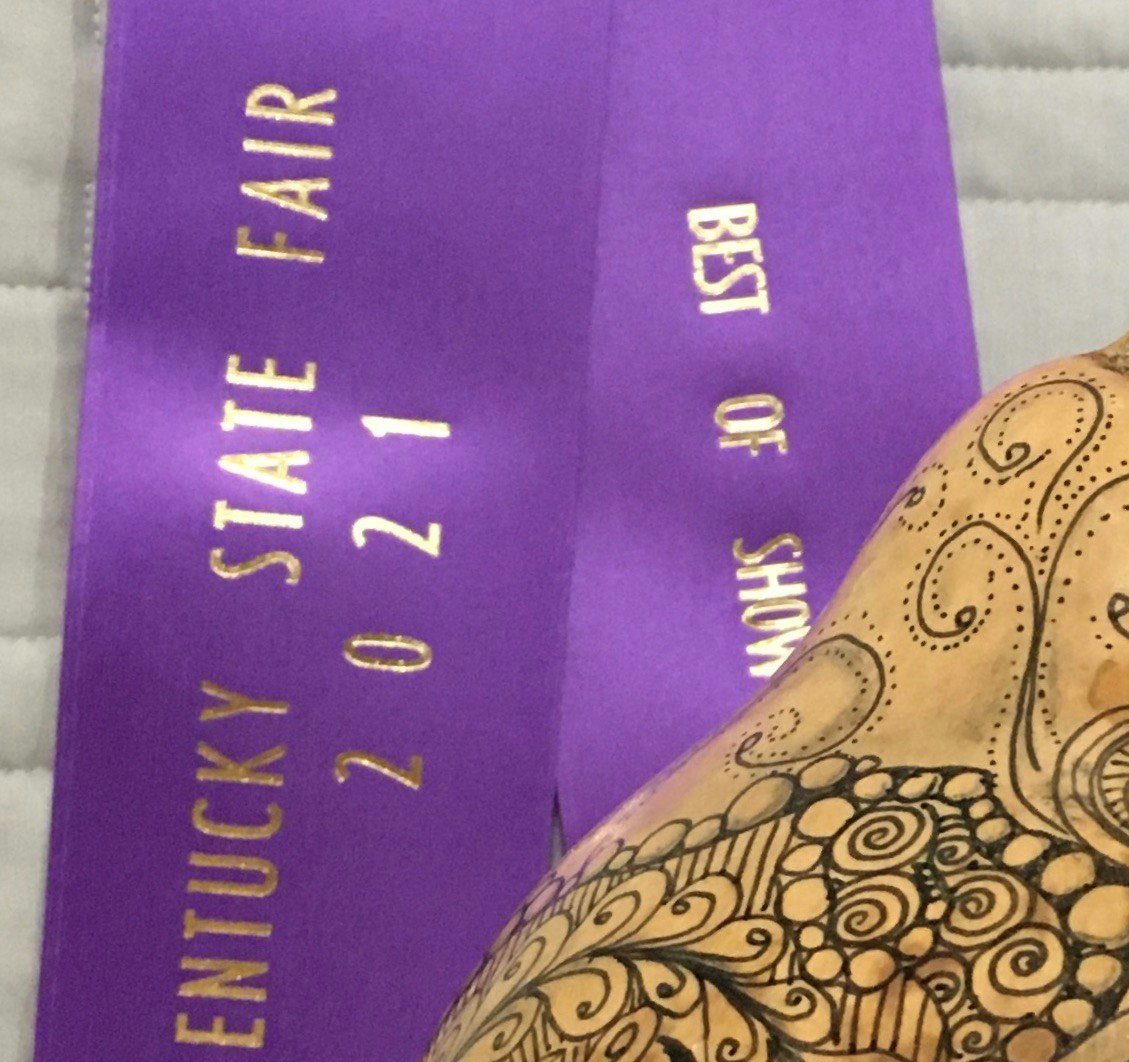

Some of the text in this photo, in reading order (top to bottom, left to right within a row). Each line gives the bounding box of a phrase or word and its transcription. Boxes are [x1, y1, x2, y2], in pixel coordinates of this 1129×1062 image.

[235, 82, 338, 265] FAIR
[210, 354, 317, 585] STATE
[687, 202, 811, 678] BEST OF SHOW
